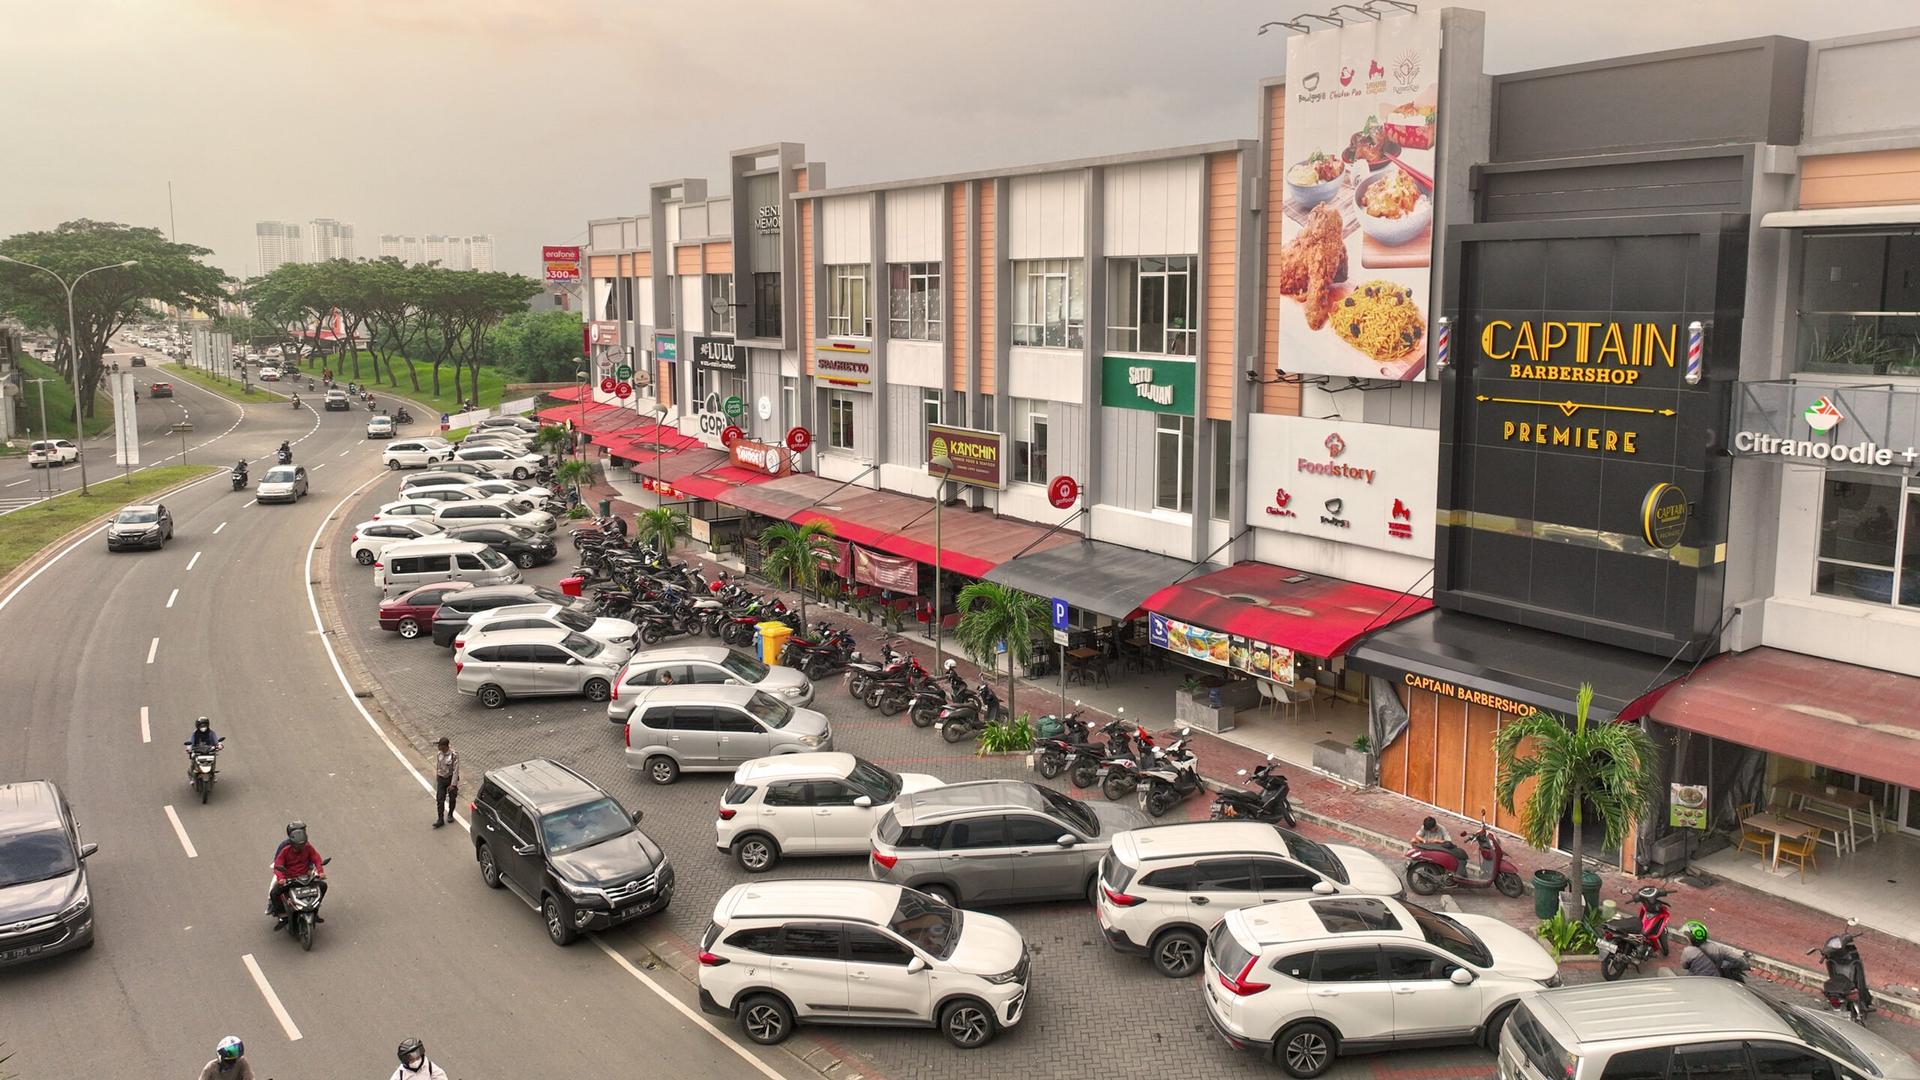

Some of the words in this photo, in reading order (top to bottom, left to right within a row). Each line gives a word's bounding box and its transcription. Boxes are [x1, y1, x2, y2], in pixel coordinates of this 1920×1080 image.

[708, 343, 734, 361] LULU
[1481, 320, 1677, 367] CAPTAIN
[1128, 366, 1153, 385] SATU
[1510, 364, 1638, 384] BARBERSHOP
[1136, 383, 1173, 405] TUJUAN
[1503, 421, 1637, 453] PREMIERE
[950, 440, 996, 461] KANCHIN
[1735, 431, 1894, 466] Citranoodle
[1298, 458, 1375, 484] Foodstory
[1056, 602, 1065, 624] P
[1405, 673, 1454, 697] CAPTAIN
[1457, 687, 1537, 717] BARBERSHOP
